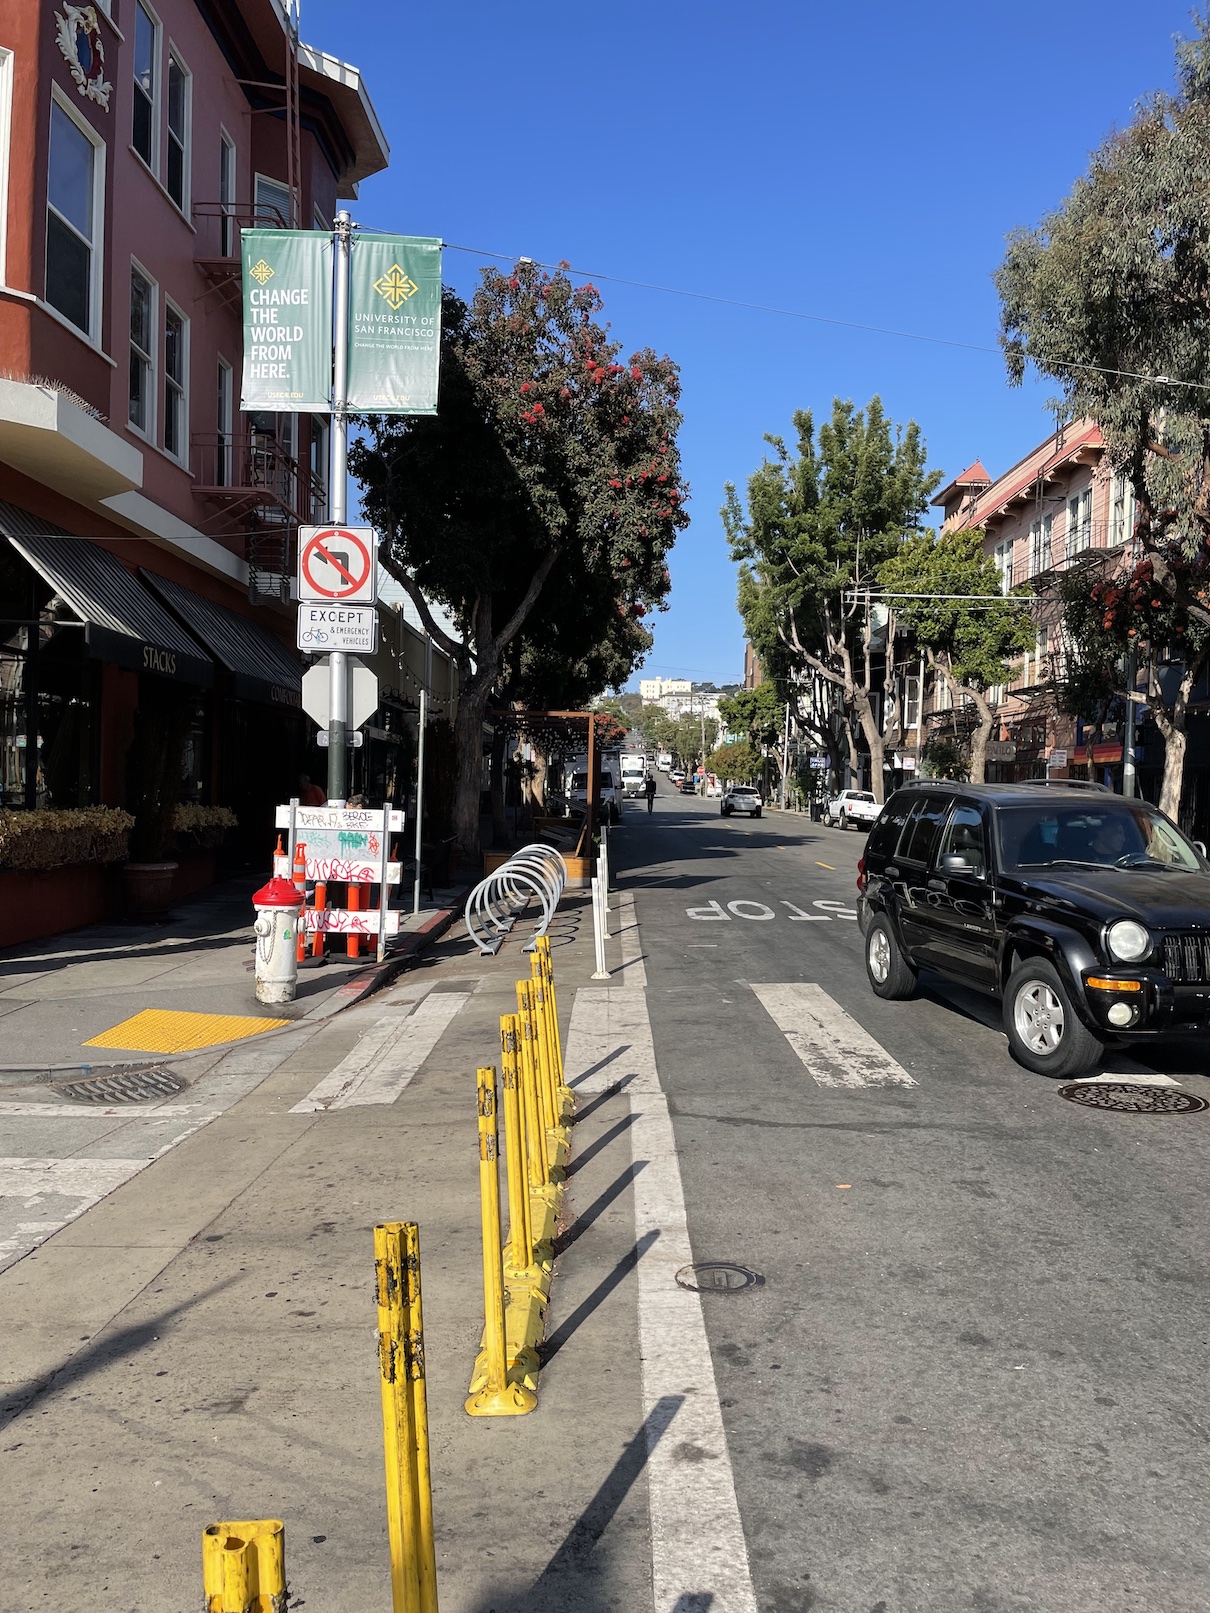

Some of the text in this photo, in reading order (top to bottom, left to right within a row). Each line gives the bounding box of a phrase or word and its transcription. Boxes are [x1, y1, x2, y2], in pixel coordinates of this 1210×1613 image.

[250, 289, 308, 305] CHANGE
[250, 308, 278, 324] THE
[355, 313, 435, 325] UNIVERSITY OF
[250, 326, 304, 342] WORLD
[355, 324, 434, 337] SAN FRANCISCO
[251, 345, 291, 360] FROM
[250, 363, 290, 378] HERE.
[310, 610, 364, 623] EXCEPT
[330, 626, 369, 635] & EMERGENCY
[342, 637, 369, 646] VEHICLES
[143, 645, 177, 675] STACKS
[685, 900, 858, 921] STOP
